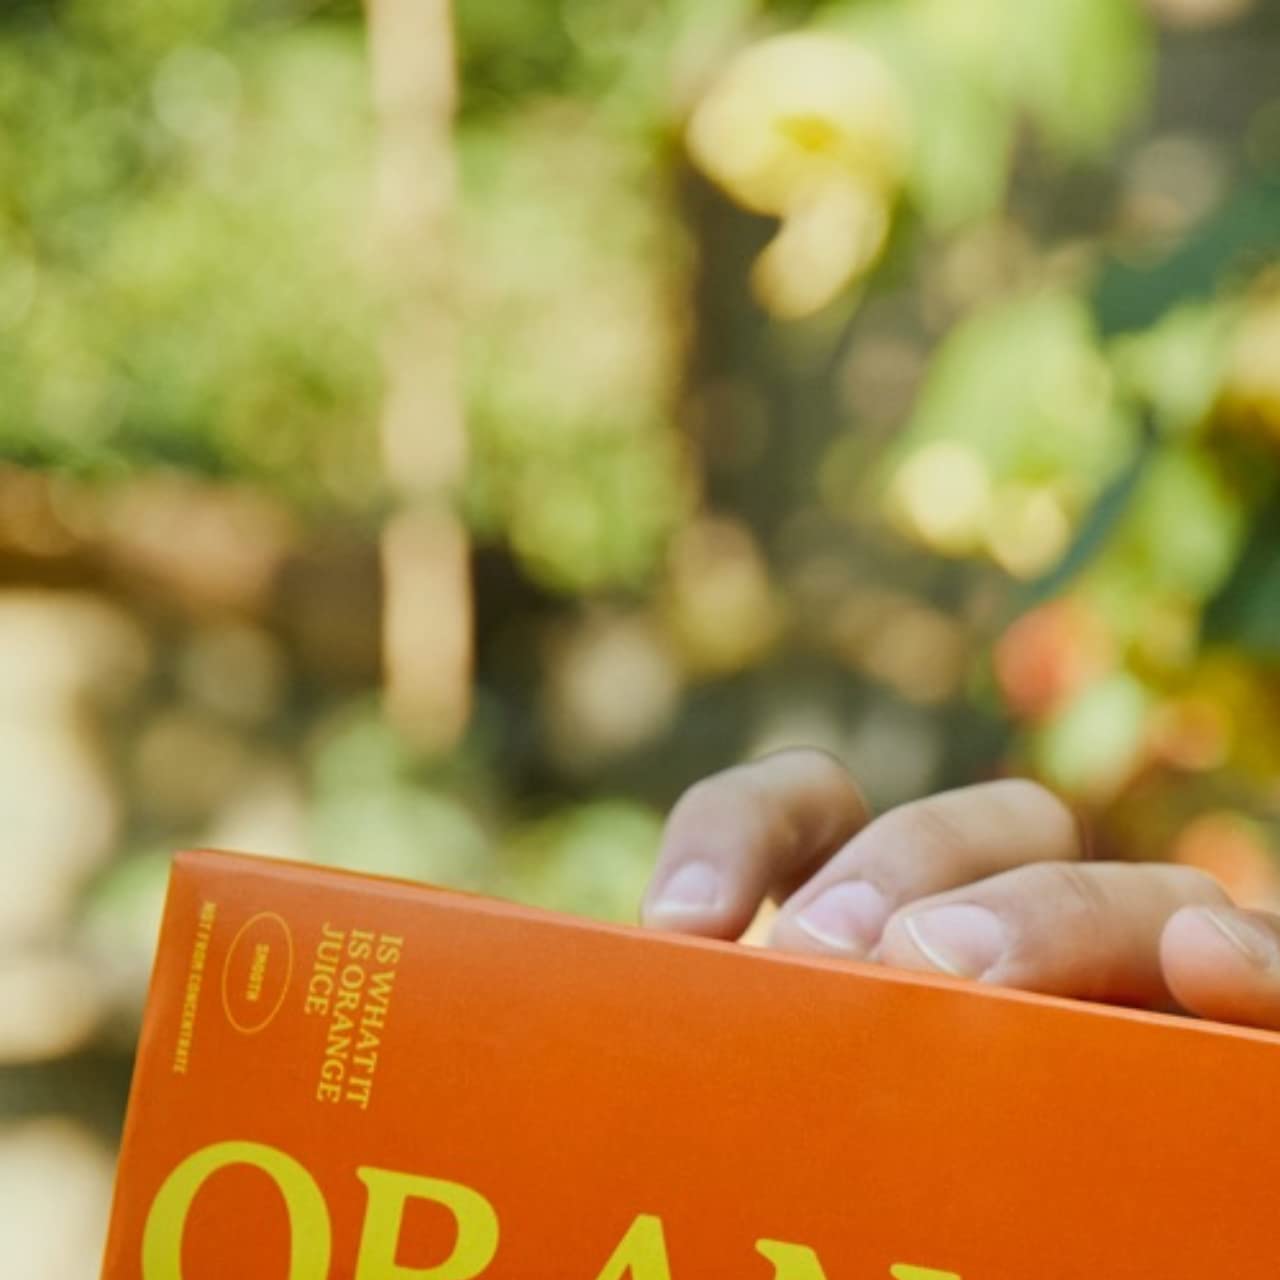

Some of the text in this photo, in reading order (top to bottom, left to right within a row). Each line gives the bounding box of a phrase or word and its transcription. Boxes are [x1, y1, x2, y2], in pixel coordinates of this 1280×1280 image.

[304, 921, 345, 1016] JUICE
[316, 928, 374, 1103] IS ORANGE
[346, 934, 404, 1110] IS WHAT IT
